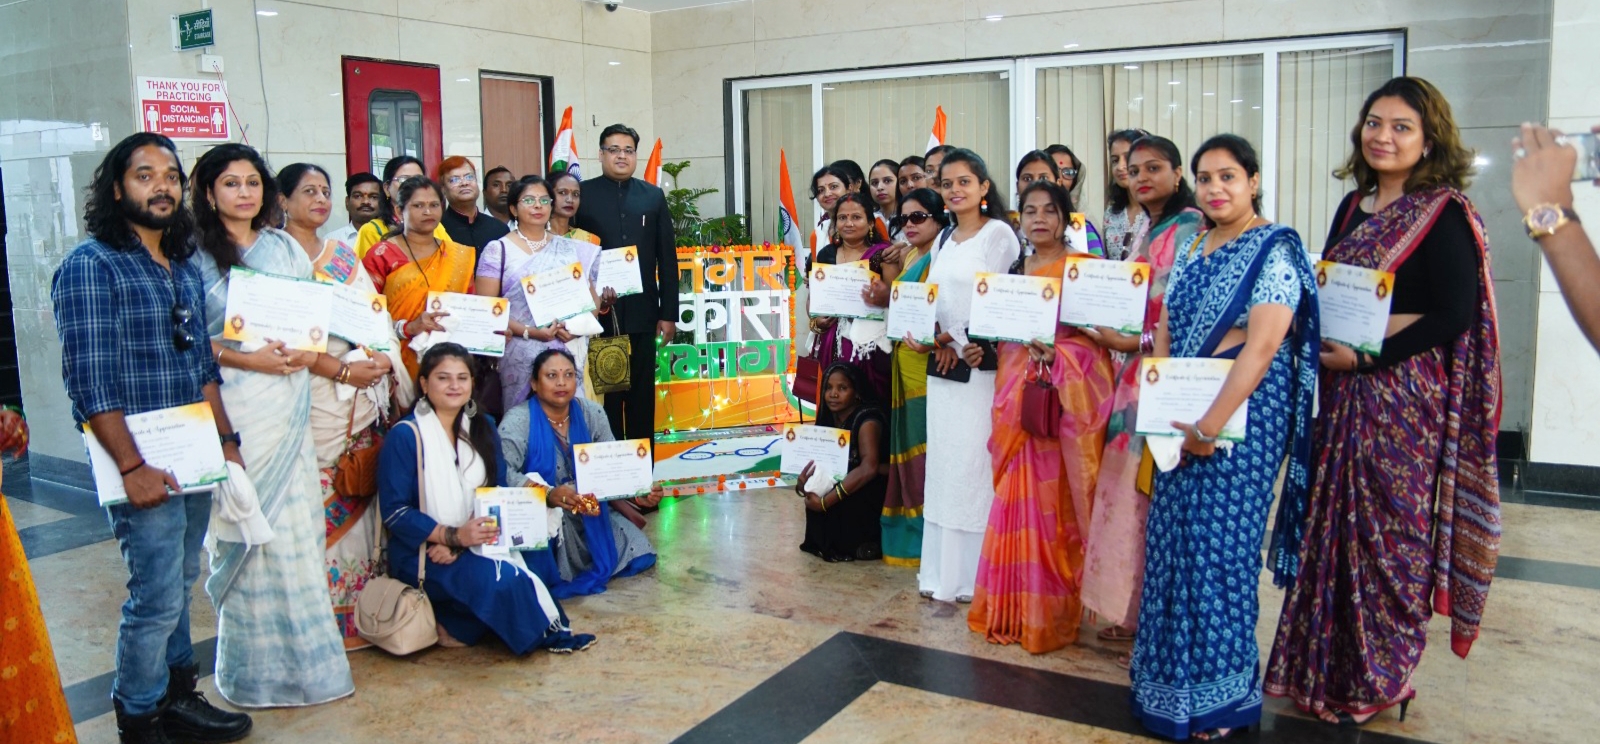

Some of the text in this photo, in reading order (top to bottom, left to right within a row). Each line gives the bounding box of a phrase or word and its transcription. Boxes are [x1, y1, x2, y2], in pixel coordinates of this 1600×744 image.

[146, 80, 220, 92] THANK YOU FOR
[156, 91, 211, 101] PRACTICING
[170, 104, 200, 113] SOCIAL
[162, 114, 209, 123] DISTANCING
[675, 289, 791, 342] कास
